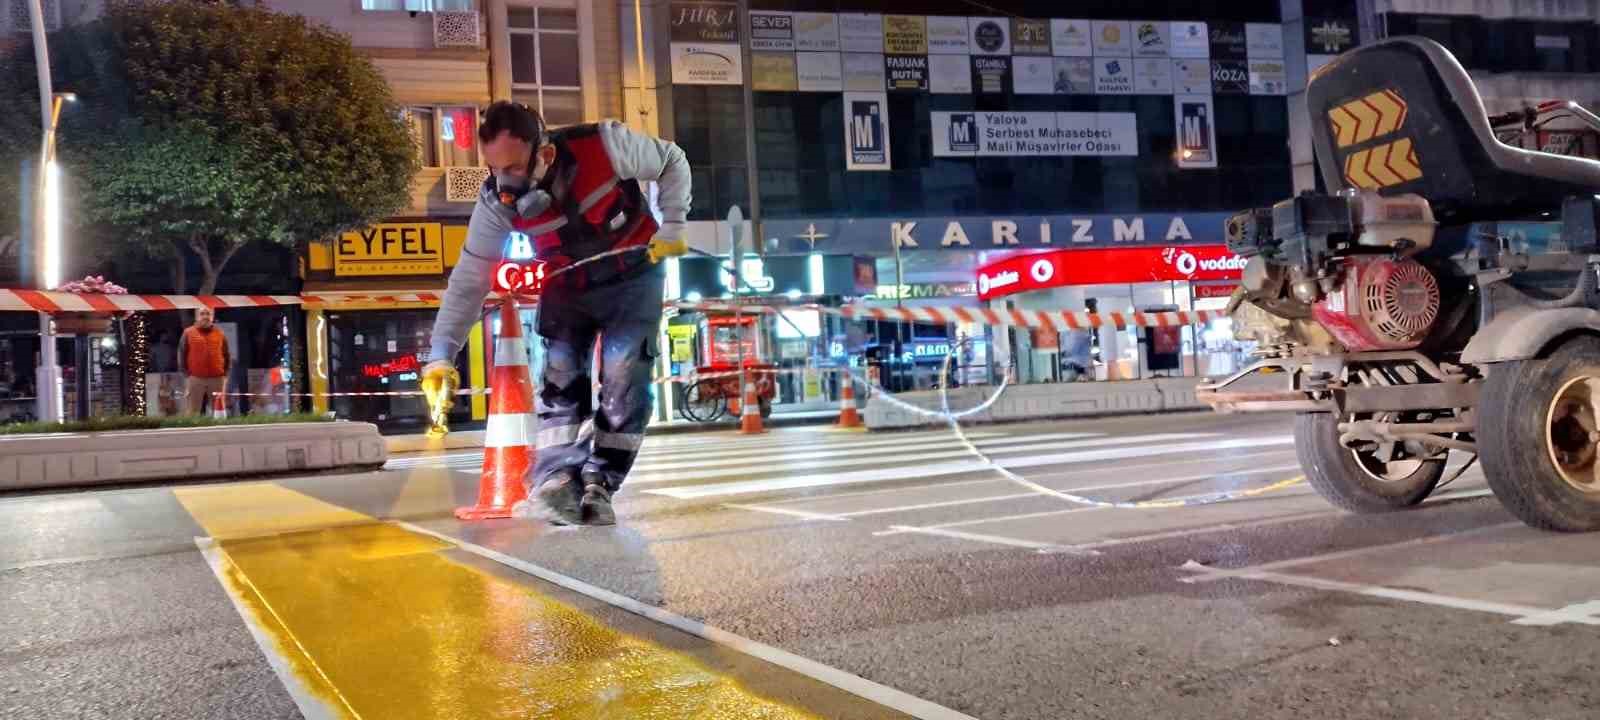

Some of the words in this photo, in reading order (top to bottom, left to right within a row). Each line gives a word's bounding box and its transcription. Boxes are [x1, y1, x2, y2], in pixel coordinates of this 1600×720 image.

[751, 17, 791, 27] SEVER
[1213, 67, 1247, 81] KOZA
[985, 113, 1027, 125] Yalova
[986, 128, 1034, 138] Serbest
[1038, 127, 1112, 138] Muhasebeci
[987, 141, 1012, 152] Mali
[1085, 141, 1121, 152] Odası
[338, 227, 437, 255] EYFEL
[1199, 254, 1249, 270] vodafo
